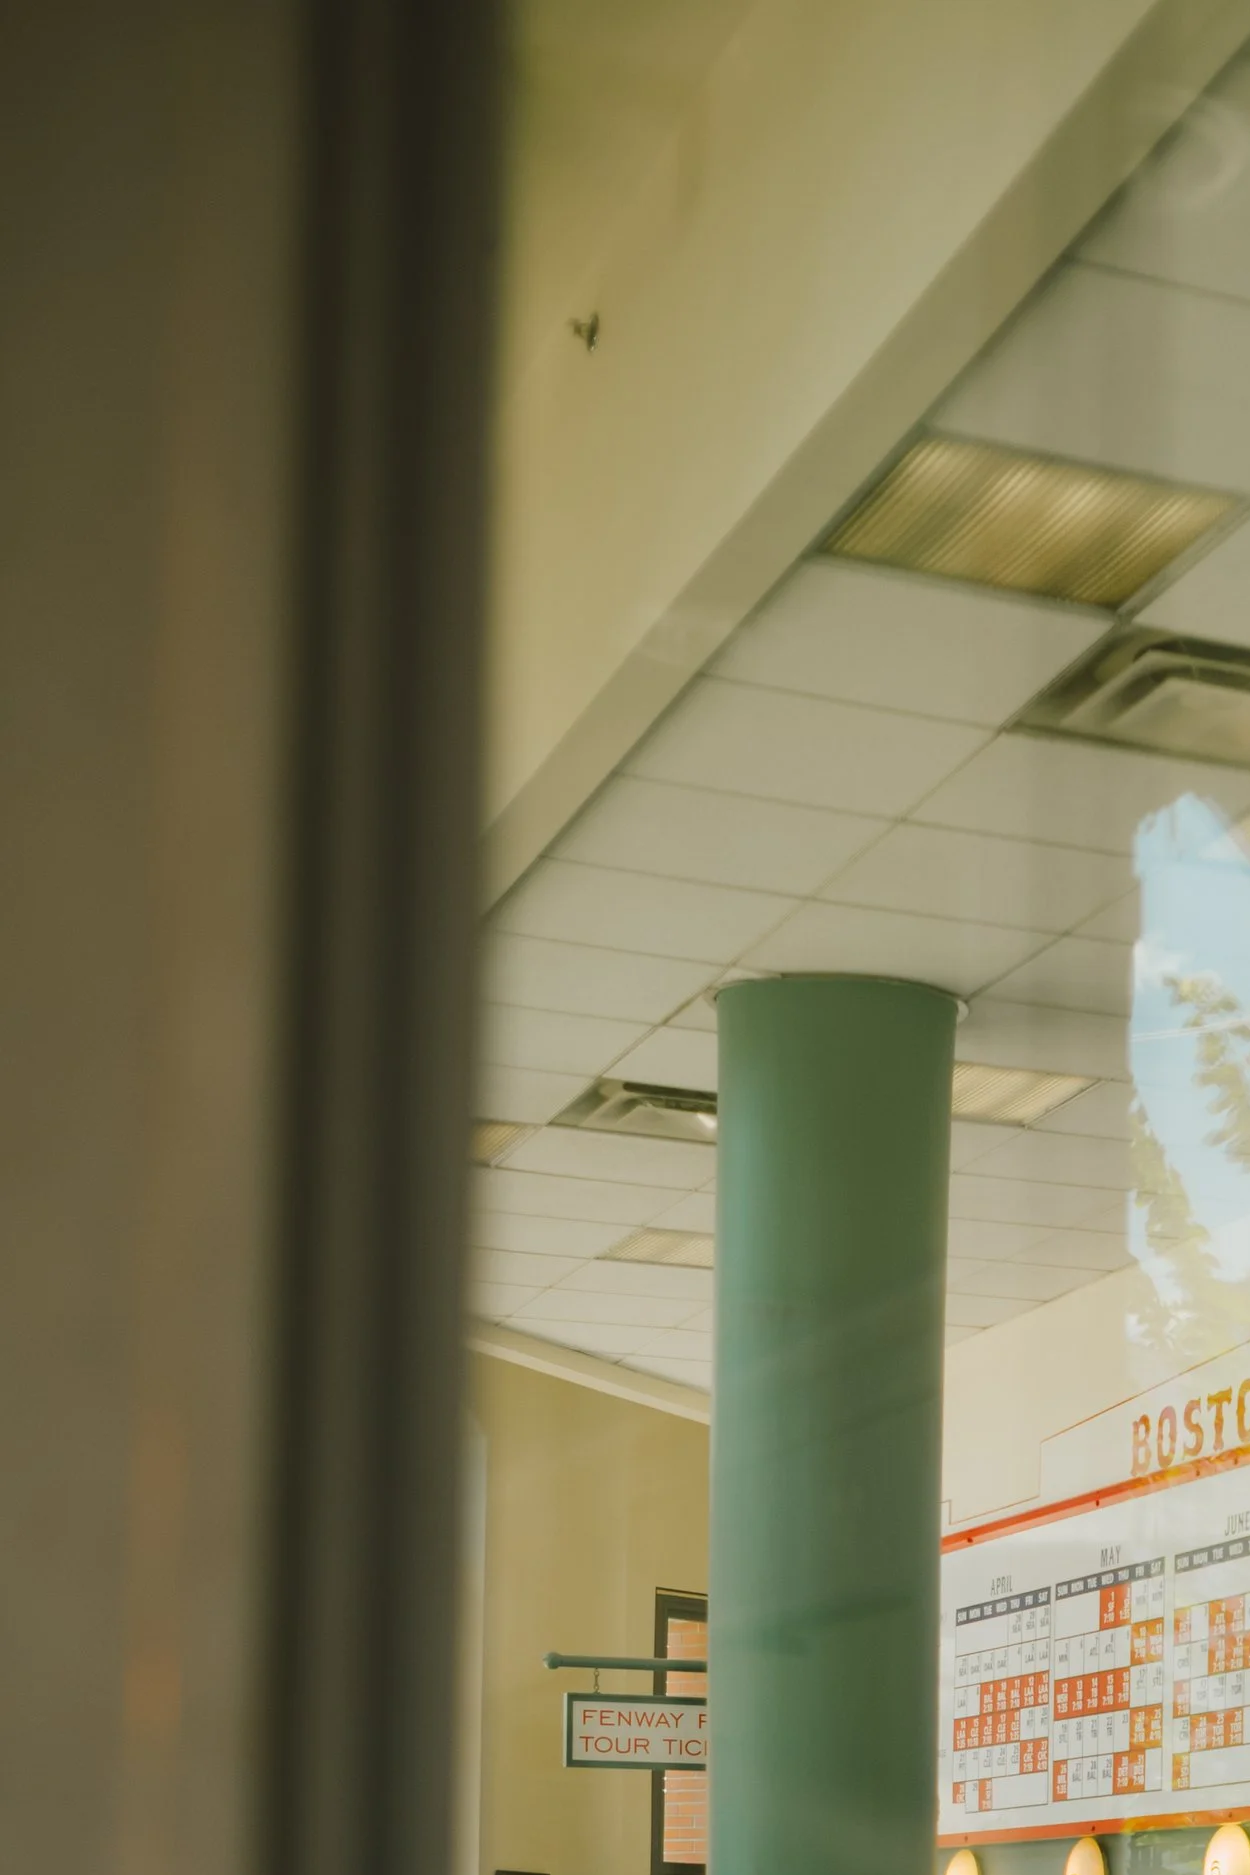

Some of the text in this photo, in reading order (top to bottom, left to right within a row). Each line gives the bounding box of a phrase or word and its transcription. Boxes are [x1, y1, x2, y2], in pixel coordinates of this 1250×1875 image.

[1224, 1511, 1250, 1536] JUNE
[1101, 1545, 1121, 1567] MAY
[990, 1575, 1014, 1596] APRIL
[582, 1709, 684, 1728] FENWAY
[579, 1736, 707, 1756] TOUR TIC
